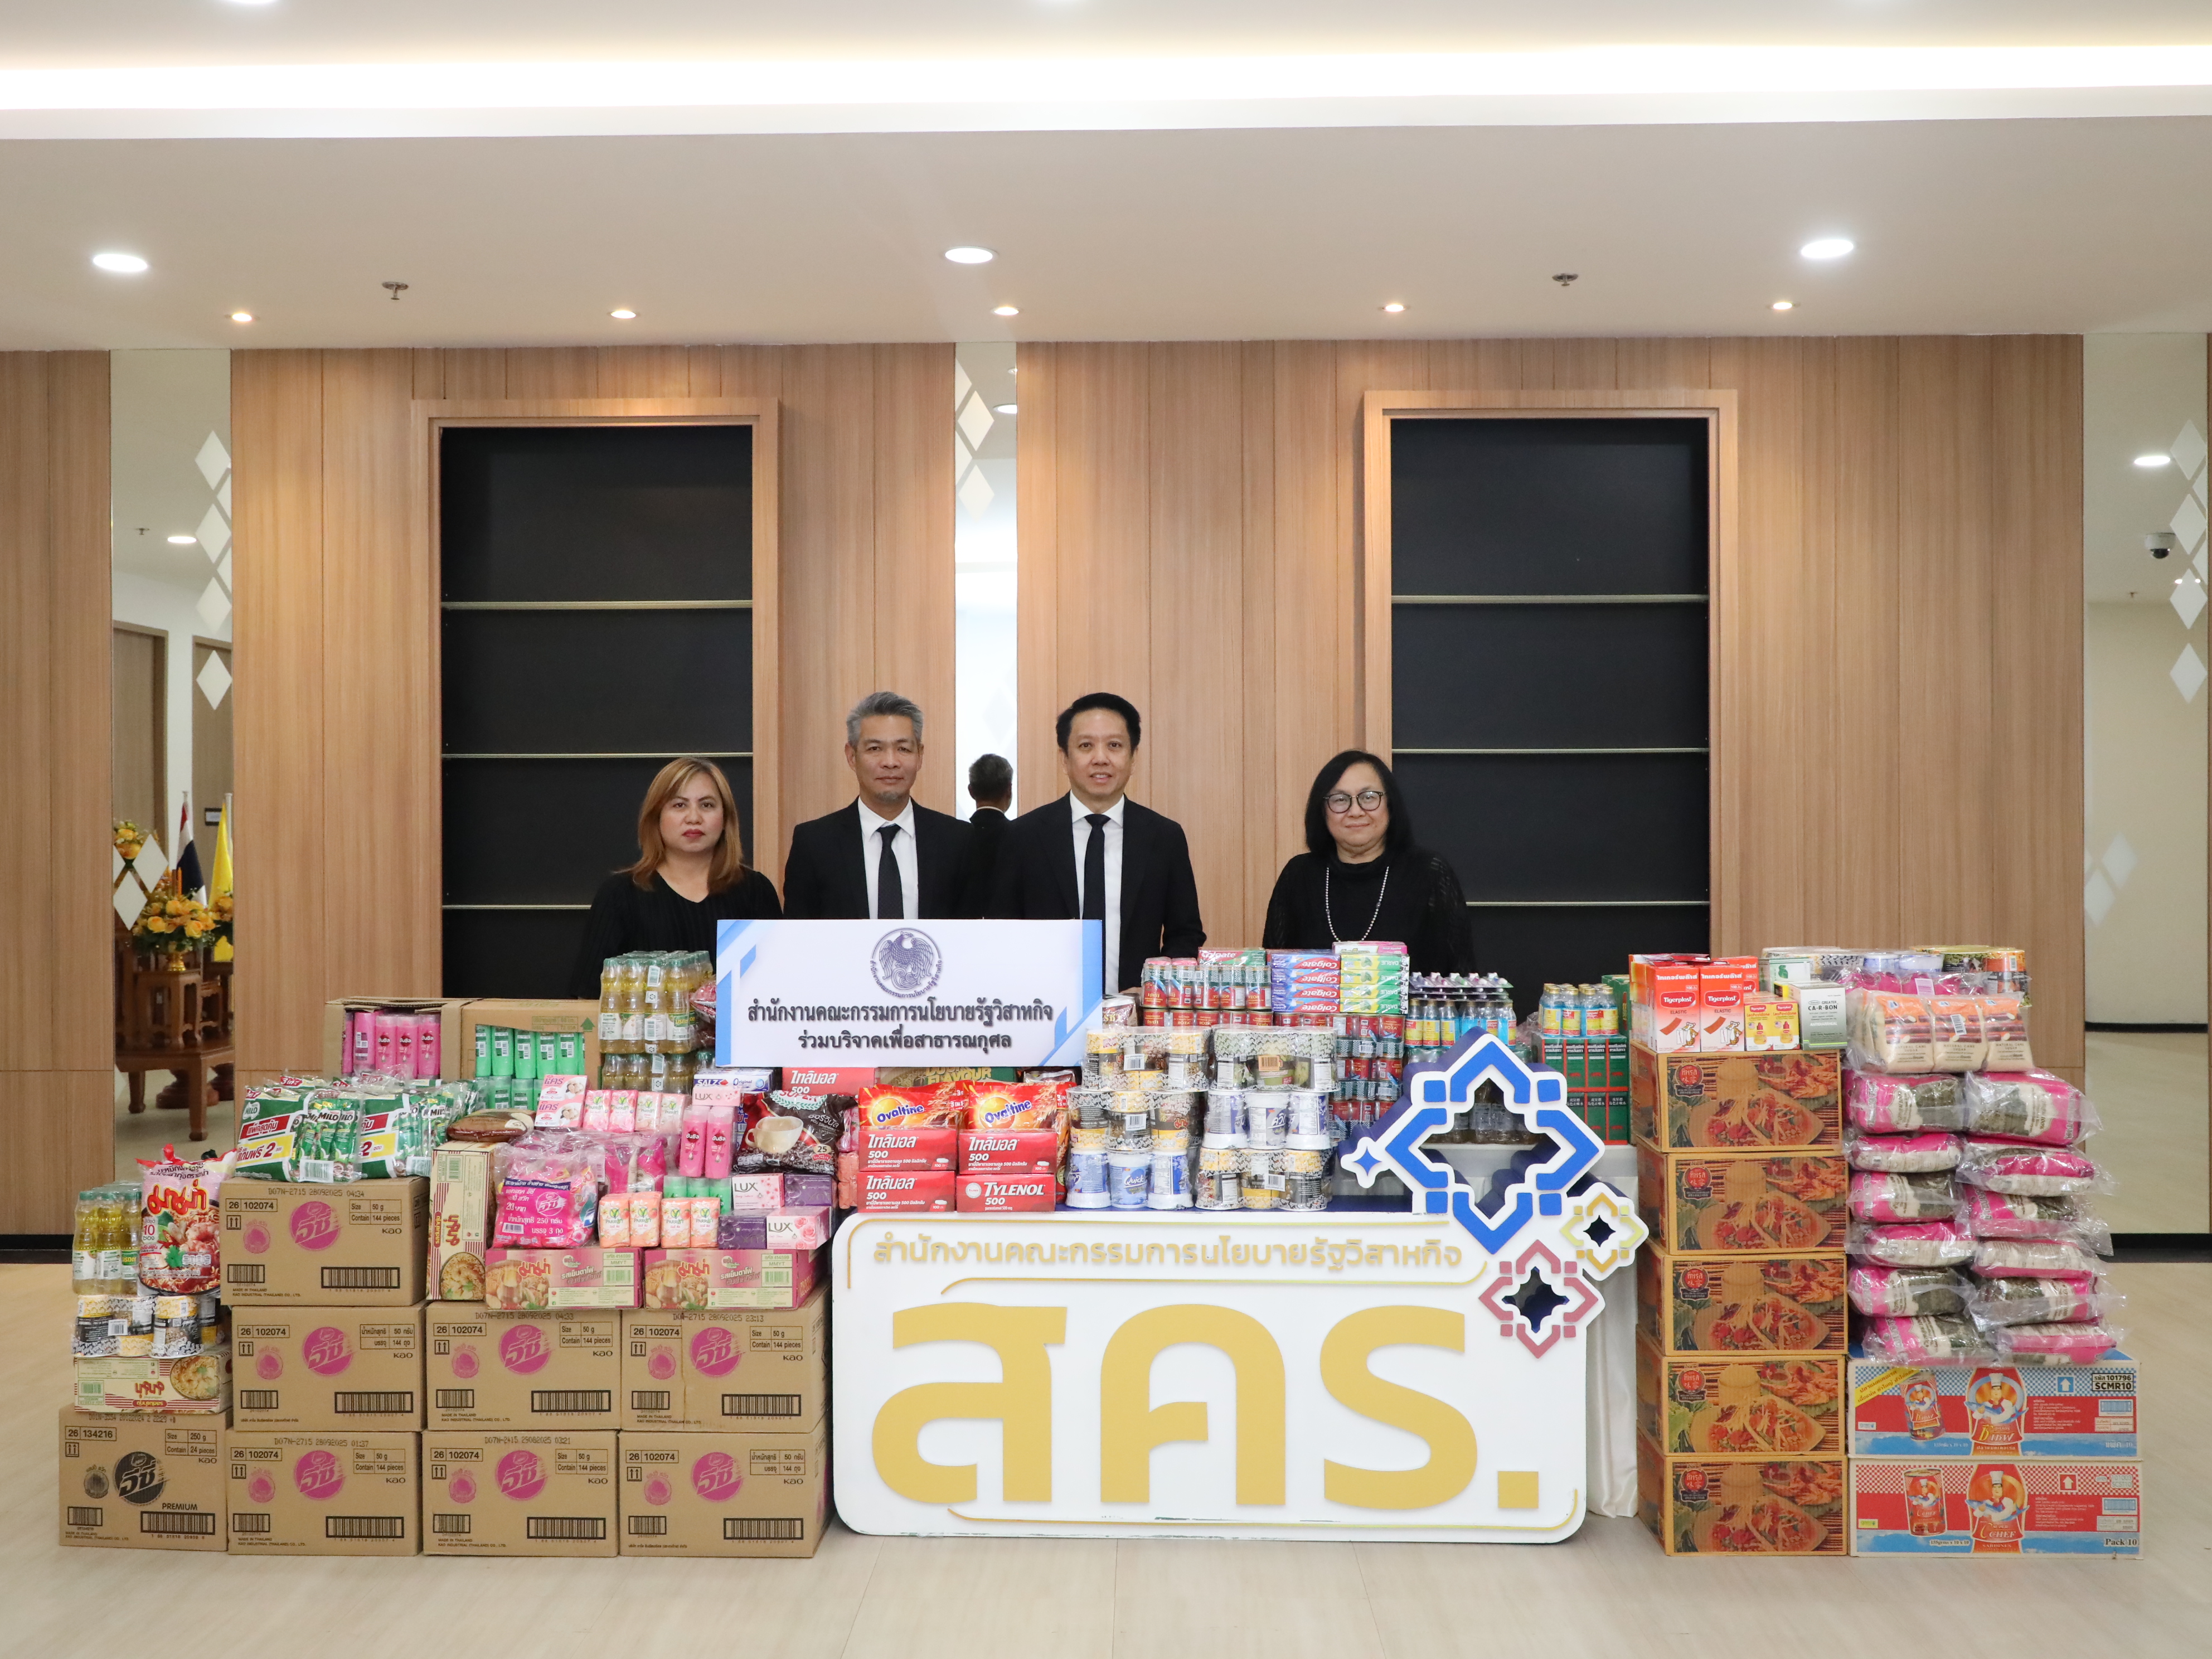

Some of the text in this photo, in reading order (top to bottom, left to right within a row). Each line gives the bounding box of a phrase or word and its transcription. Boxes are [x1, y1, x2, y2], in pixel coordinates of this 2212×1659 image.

[1302, 975, 1337, 983] Colgate
[1302, 989, 1337, 997] Colgate
[748, 997, 1053, 1026] สำนักงานคณะกรรมการนโยบายรัฐวิสาหกิจ
[1301, 1003, 1337, 1012] Colgate
[798, 1024, 1011, 1055] ร่วมบริจาคเพื่อสาธารณกุศล
[790, 1070, 837, 1084] ไทลินอล
[318, 1112, 338, 1120] MILO
[877, 1105, 924, 1122] Ovaltine
[985, 1100, 1031, 1123] Ovaltine
[868, 1134, 917, 1148] ไทลินอล
[968, 1137, 1017, 1152] ไทลินอล
[263, 1142, 275, 1157] 2
[868, 1150, 889, 1158] 500
[968, 1153, 989, 1161] 500
[734, 1182, 758, 1192] LUX
[866, 1176, 915, 1190] ไทลินอล
[984, 1182, 1044, 1197] TYLENOL
[147, 1178, 209, 1216] มาม่า
[144, 1224, 155, 1235] 10
[444, 1214, 460, 1246] มาม่า
[768, 1223, 793, 1232] LUX
[873, 1231, 1463, 1270] สำนักงานคณะกรรมการนโยบายรัฐวิสาหกิจ
[518, 1258, 552, 1278] มาม่า
[677, 1258, 711, 1278] มาม่า
[135, 1381, 165, 1399] มาม่า
[871, 1301, 1539, 1510] สคร.
